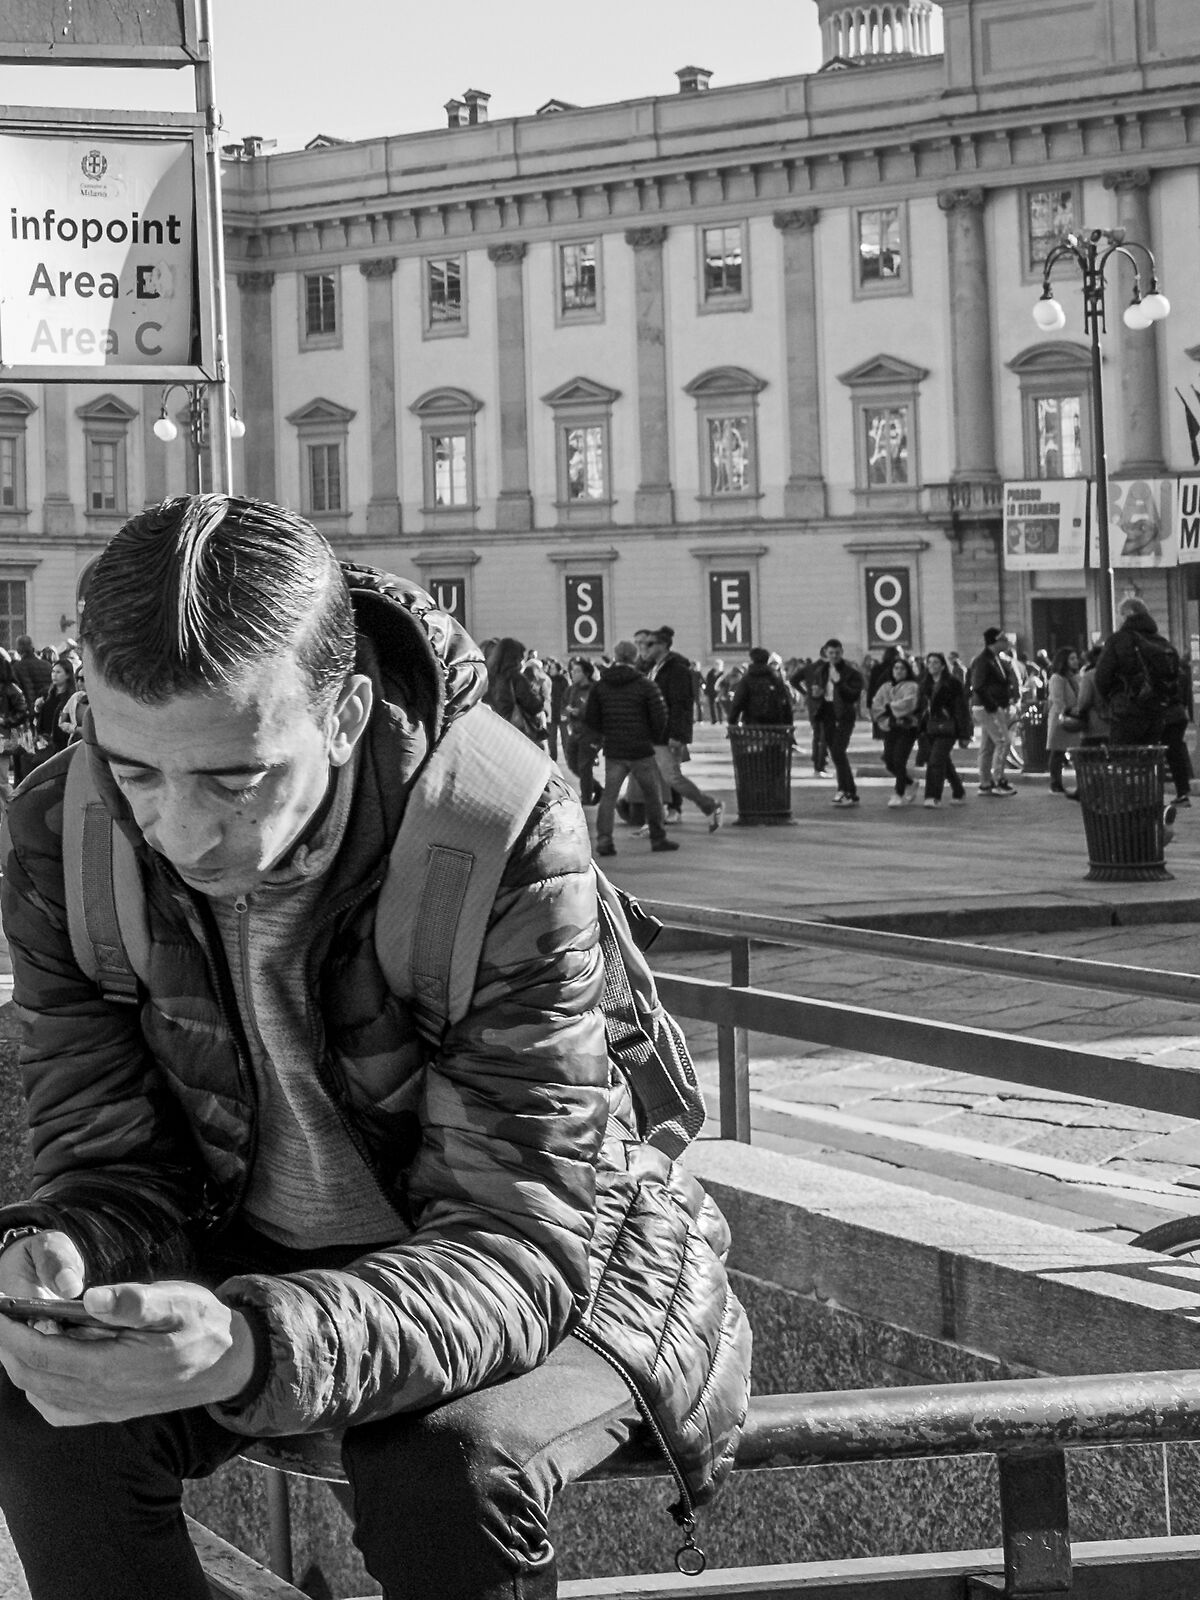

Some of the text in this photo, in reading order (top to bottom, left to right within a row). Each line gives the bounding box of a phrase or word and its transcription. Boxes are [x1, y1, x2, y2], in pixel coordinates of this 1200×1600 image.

[10, 208, 181, 249] infopoint
[29, 262, 119, 299] Area
[30, 319, 163, 356] Area C
